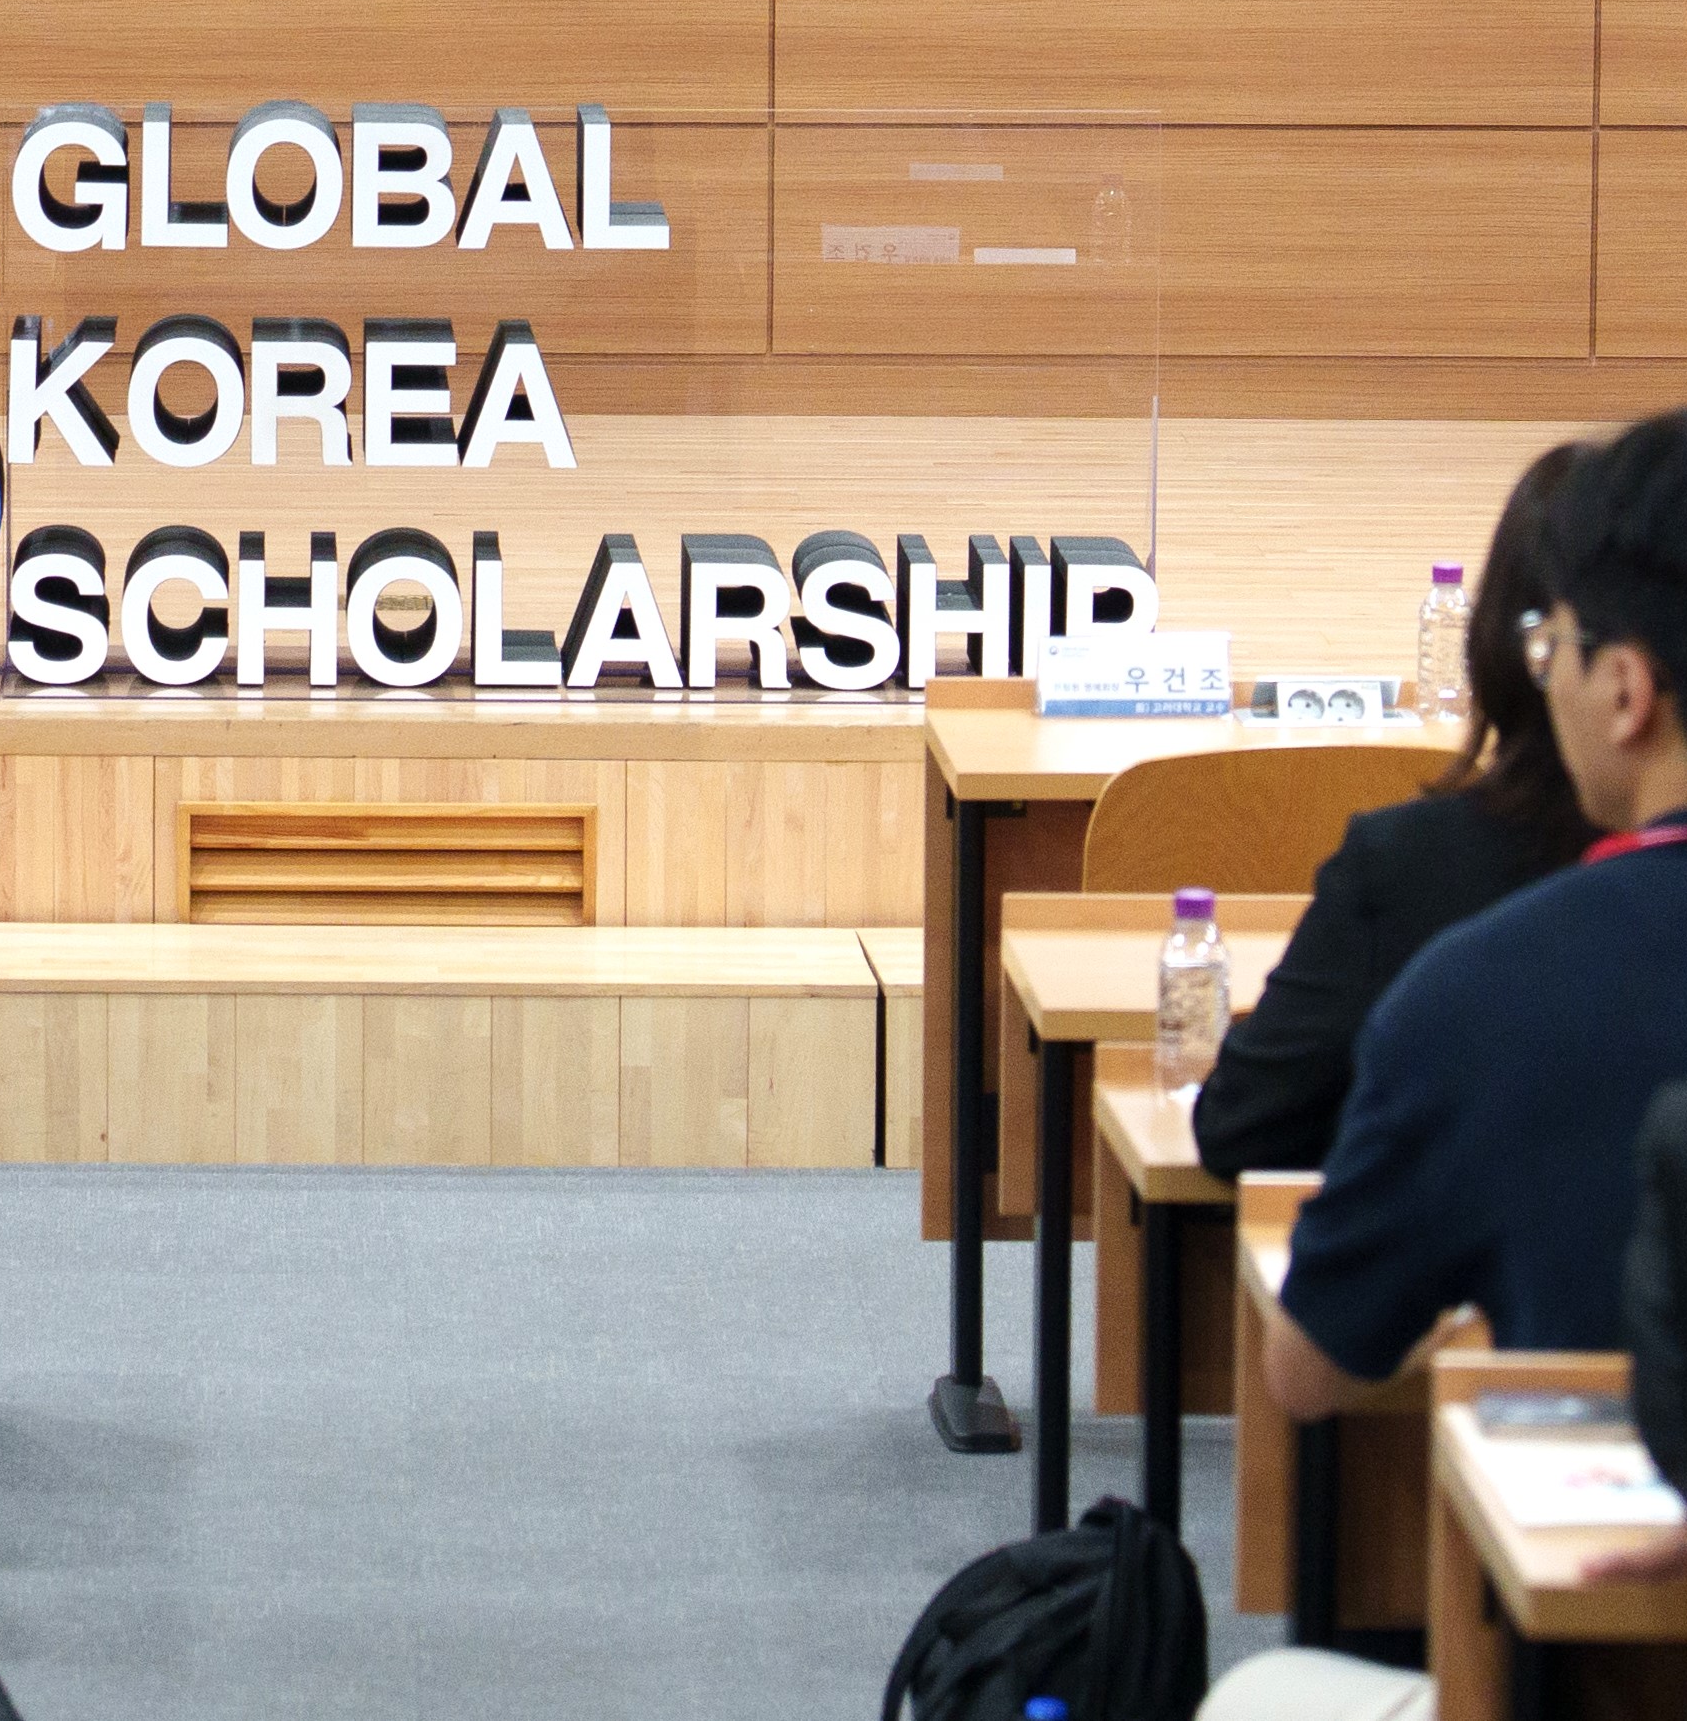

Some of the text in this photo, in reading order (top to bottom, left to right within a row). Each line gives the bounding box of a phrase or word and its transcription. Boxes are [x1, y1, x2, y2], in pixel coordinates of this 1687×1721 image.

[11, 102, 671, 253] GLOBAL
[7, 315, 578, 469] KOREA
[7, 525, 1160, 691] SCHOLARSHIP
